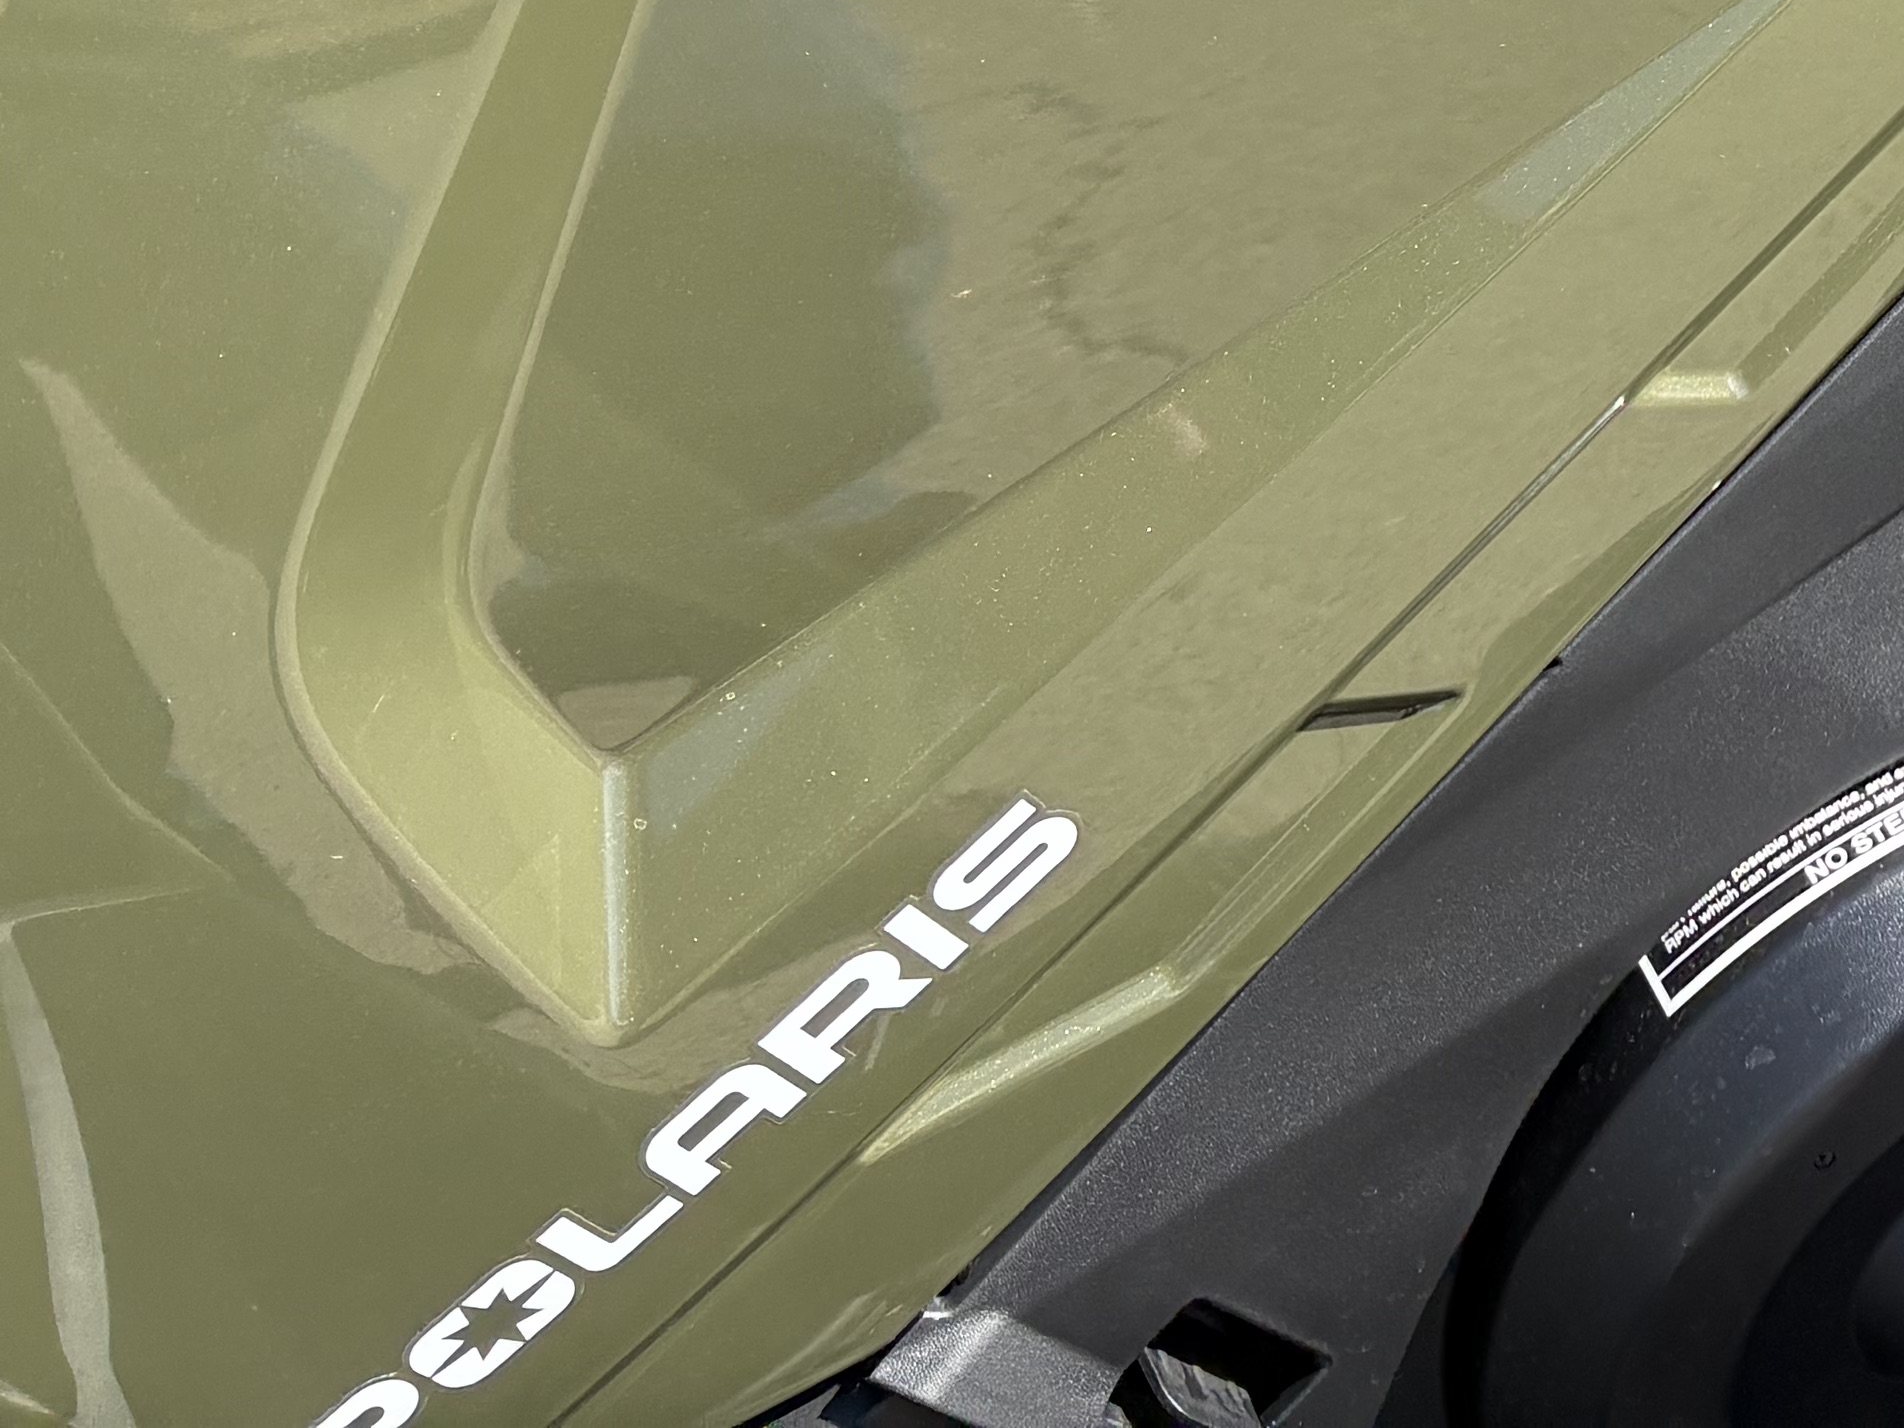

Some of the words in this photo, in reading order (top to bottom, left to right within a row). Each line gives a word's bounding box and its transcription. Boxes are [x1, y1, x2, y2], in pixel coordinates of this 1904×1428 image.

[1663, 918, 1699, 954] RPM
[1697, 886, 1741, 925] which
[1738, 867, 1768, 894] can
[1765, 842, 1808, 876] result
[1806, 830, 1823, 847] in
[1821, 800, 1875, 837] serious
[1803, 846, 1849, 885] NO
